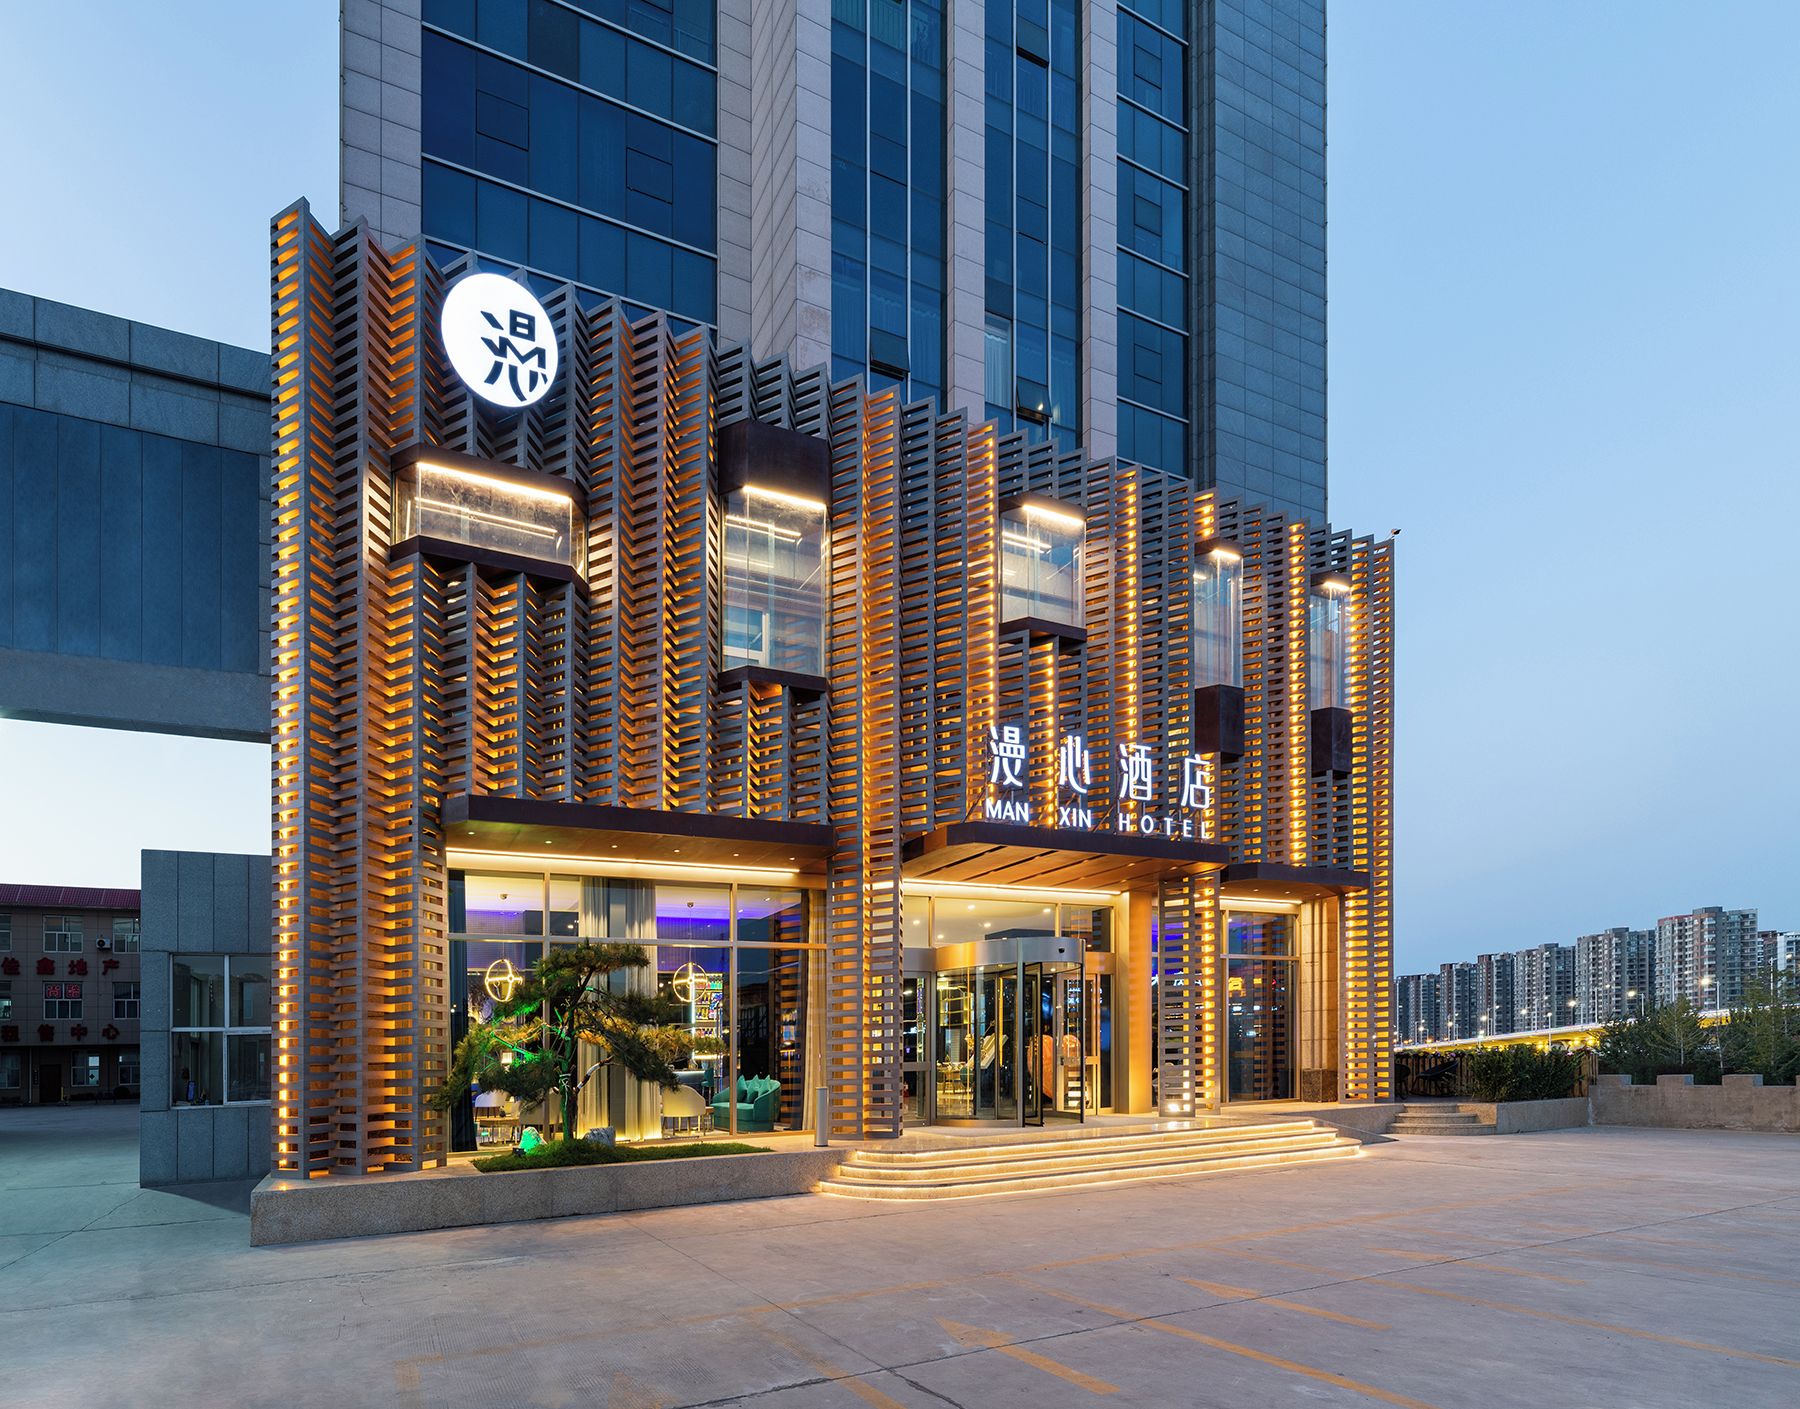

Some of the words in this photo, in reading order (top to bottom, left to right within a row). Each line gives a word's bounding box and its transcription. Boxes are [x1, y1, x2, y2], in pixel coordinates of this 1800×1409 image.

[989, 726, 1210, 809] 漫心酒店
[985, 799, 1029, 823] MAN
[1059, 806, 1092, 829] XIN
[1118, 813, 1210, 839] HOTEL
